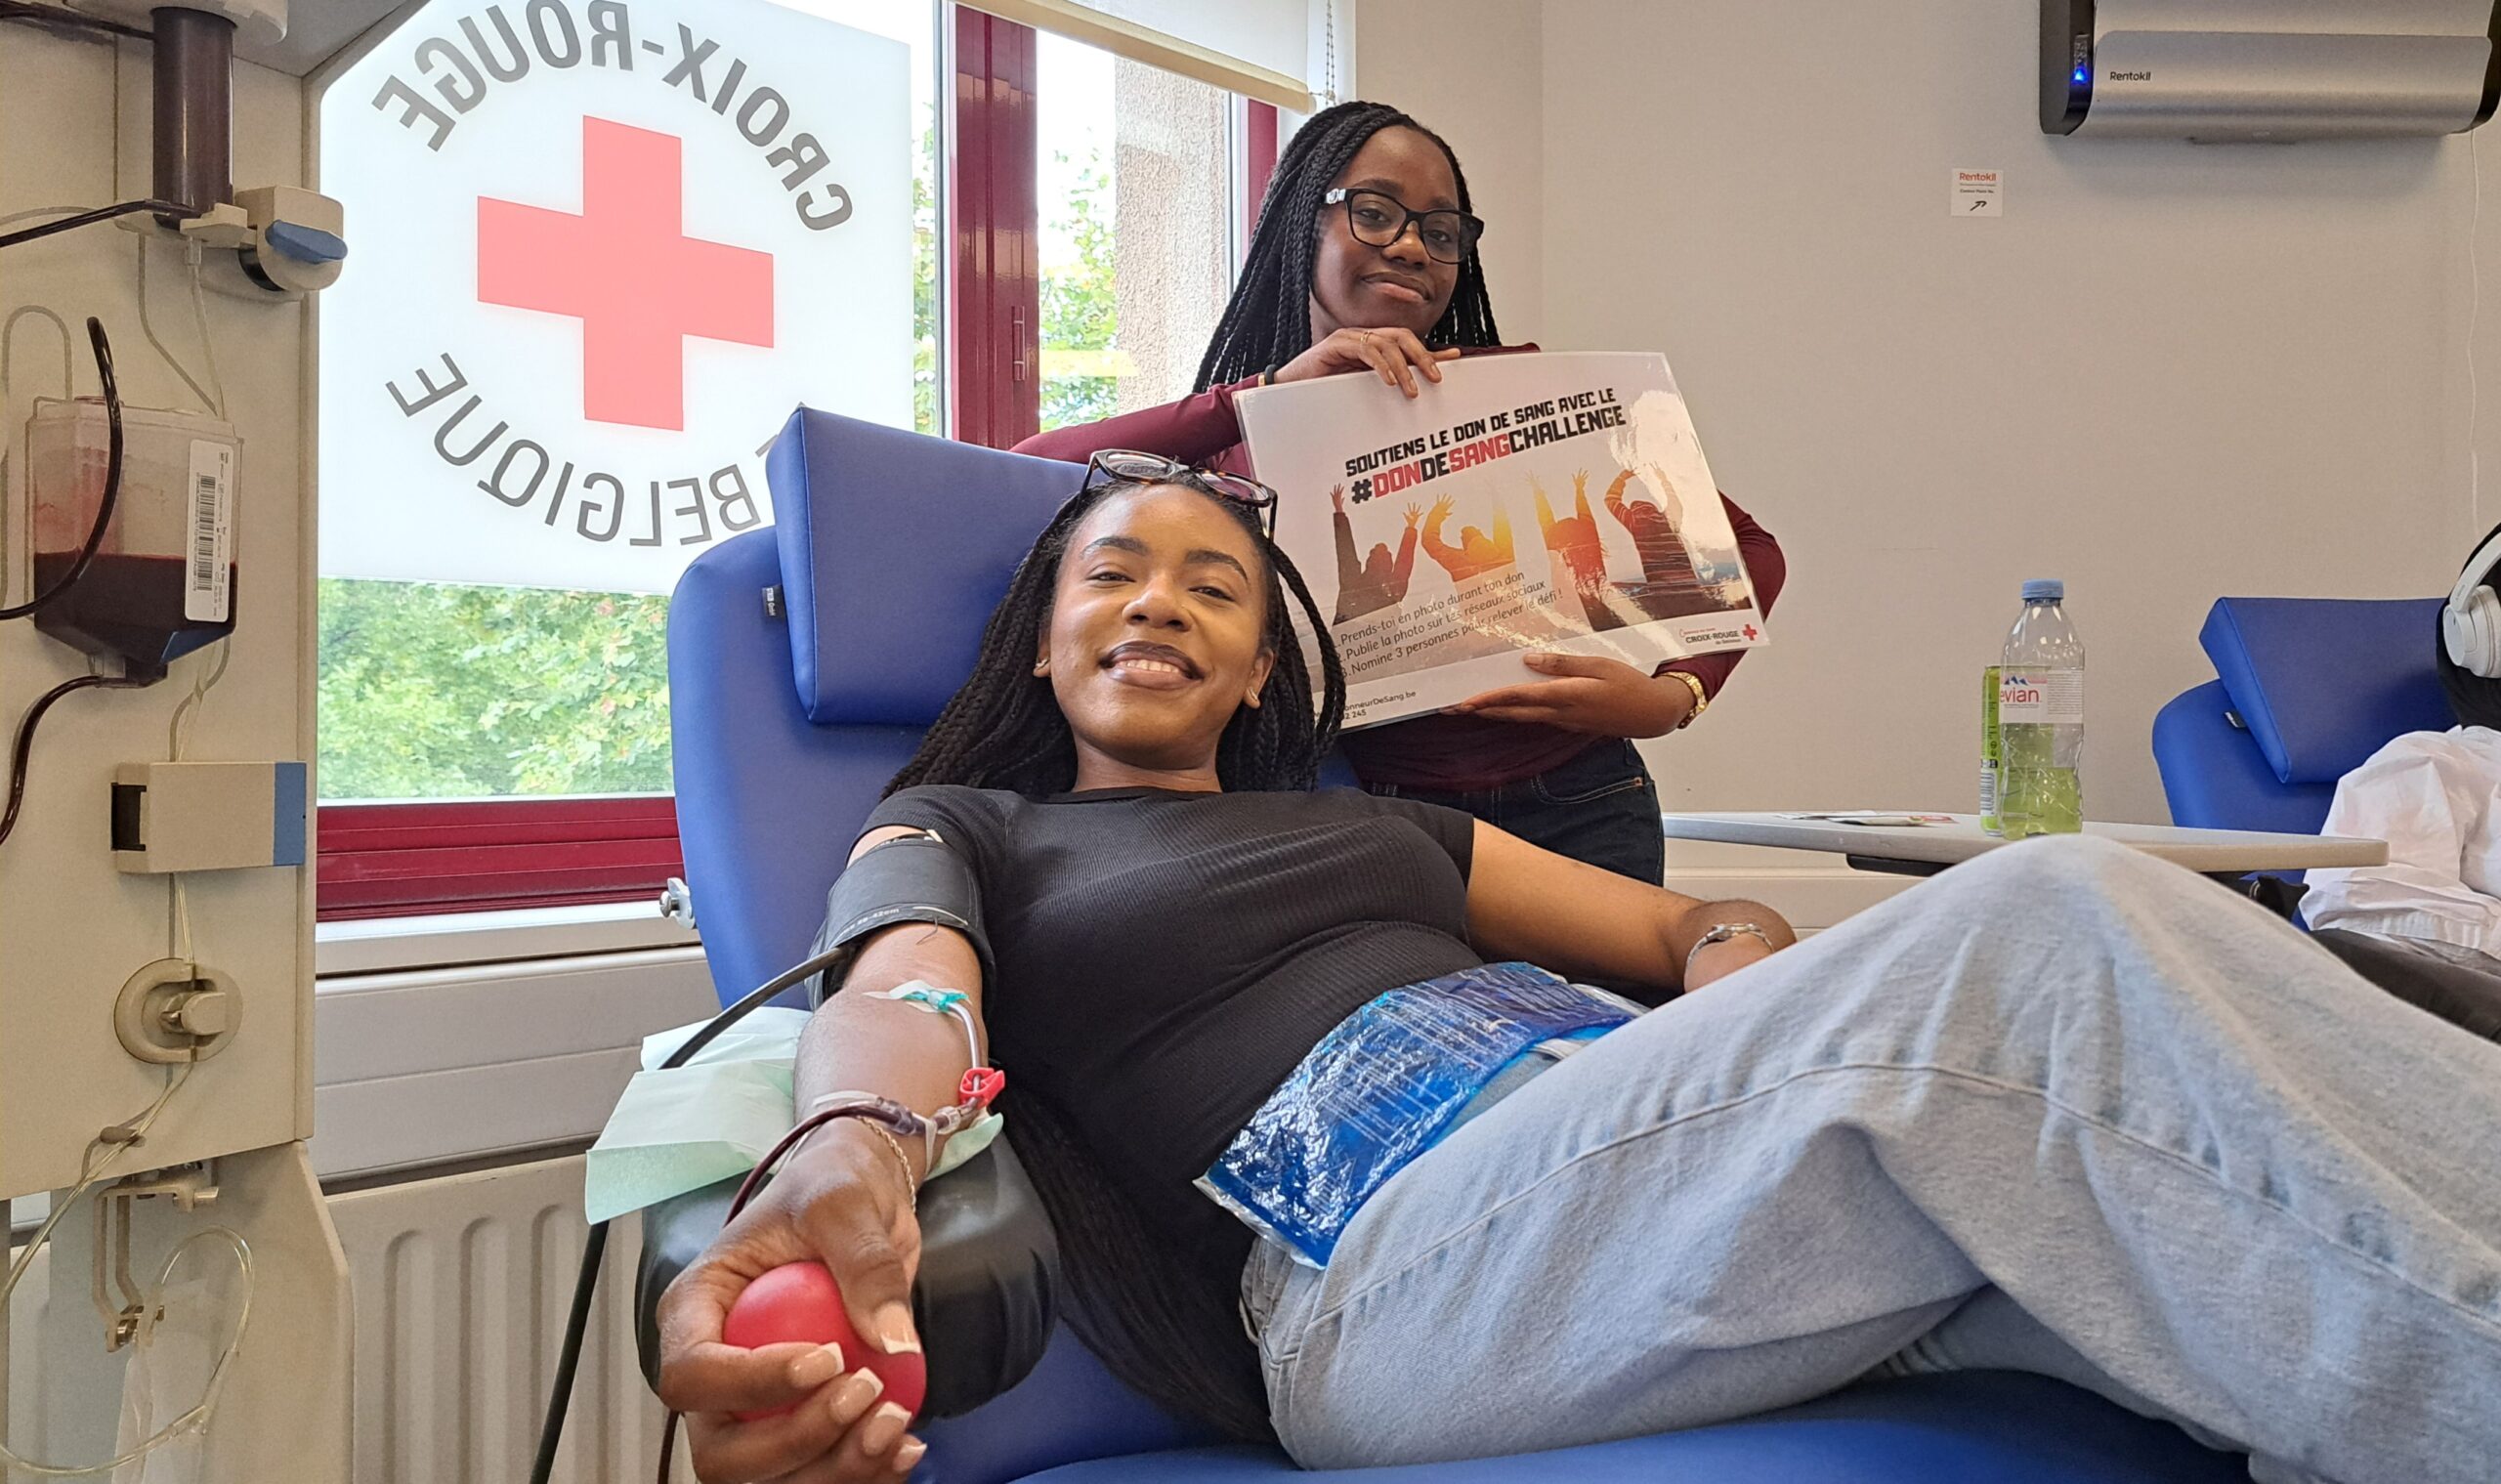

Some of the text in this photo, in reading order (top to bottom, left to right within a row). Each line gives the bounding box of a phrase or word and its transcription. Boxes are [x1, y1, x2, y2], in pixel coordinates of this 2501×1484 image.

[2109, 71, 2151, 81] Rentokil
[1959, 172, 1997, 182] Rentokil
[1345, 387, 1616, 477] SOUTIENS LE DON DE SANG AVEC LE
[1351, 405, 1627, 504] #DONDESANGCHALLENGE
[1335, 572, 1525, 649] .Prends-toi en photo durant ton don
[1380, 635, 1391, 647] la
[1393, 624, 1425, 645] photo
[1427, 616, 1446, 631] sur
[1446, 610, 1462, 623] tes
[1463, 596, 1505, 615] réseaux
[1506, 580, 1547, 602] sociaux
[1395, 647, 1404, 658] 3
[1405, 629, 1460, 657] personnes
[1462, 618, 1486, 636] pour
[1488, 604, 1524, 623] relever
[1525, 598, 1535, 611] le
[1537, 591, 1557, 606] défi
[1685, 630, 1740, 644] CROIX-ROUGE
[1352, 709, 1367, 719] 245
